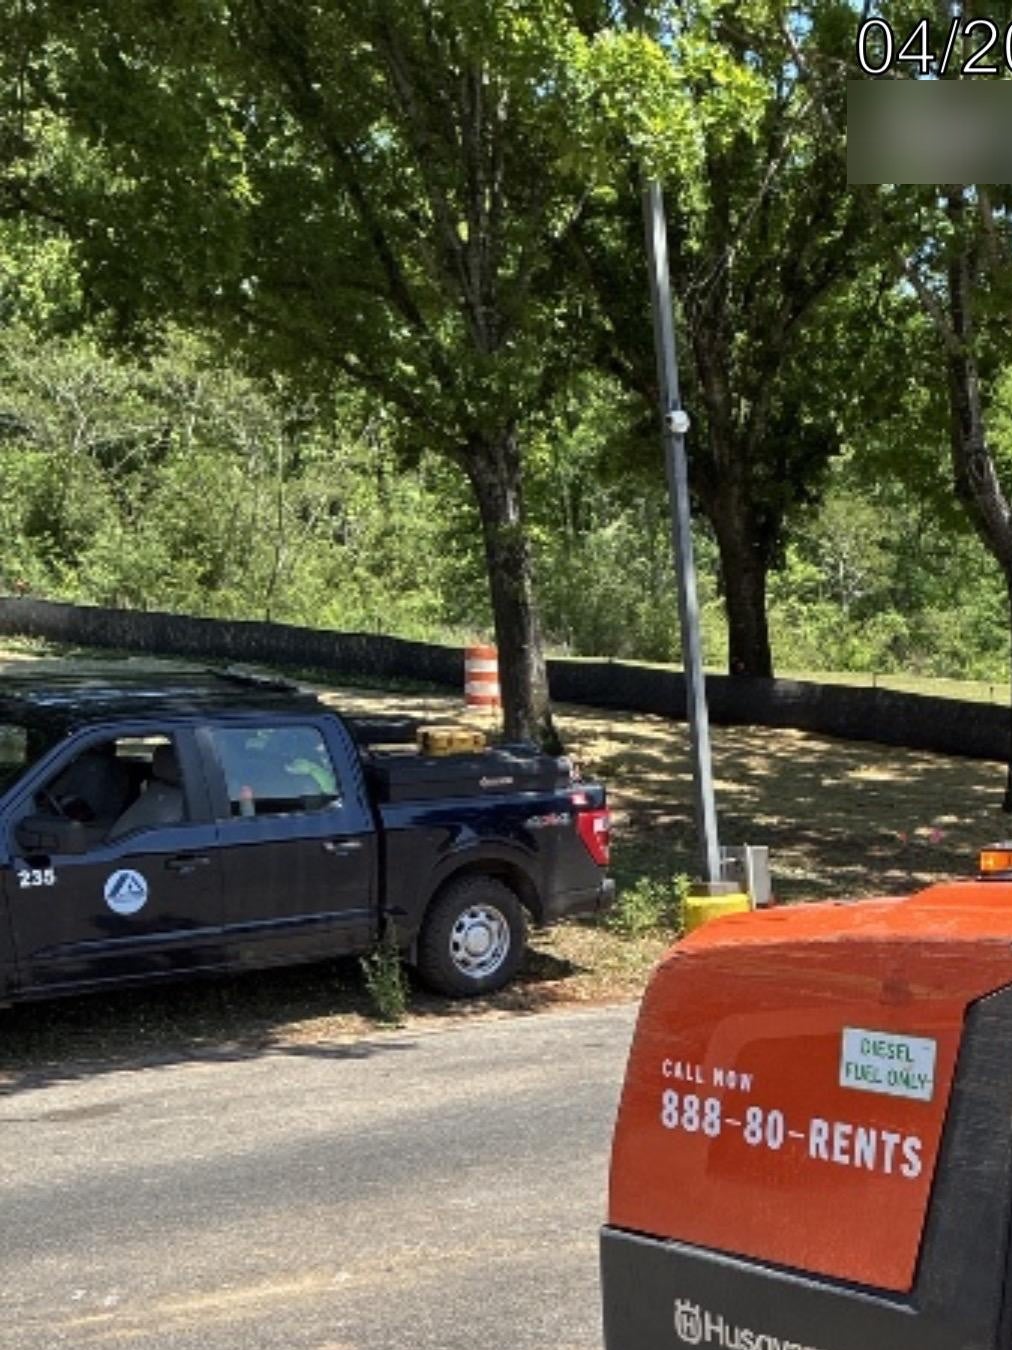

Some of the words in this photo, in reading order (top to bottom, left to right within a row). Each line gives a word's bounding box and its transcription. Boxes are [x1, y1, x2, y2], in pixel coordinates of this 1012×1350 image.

[17, 869, 56, 888] 235
[861, 1038, 915, 1062] DIESEL
[662, 1059, 705, 1084] CALL
[713, 1067, 754, 1093] NOW
[845, 1062, 882, 1083] FUEL
[661, 1088, 923, 1179] 888-80-RENTS
